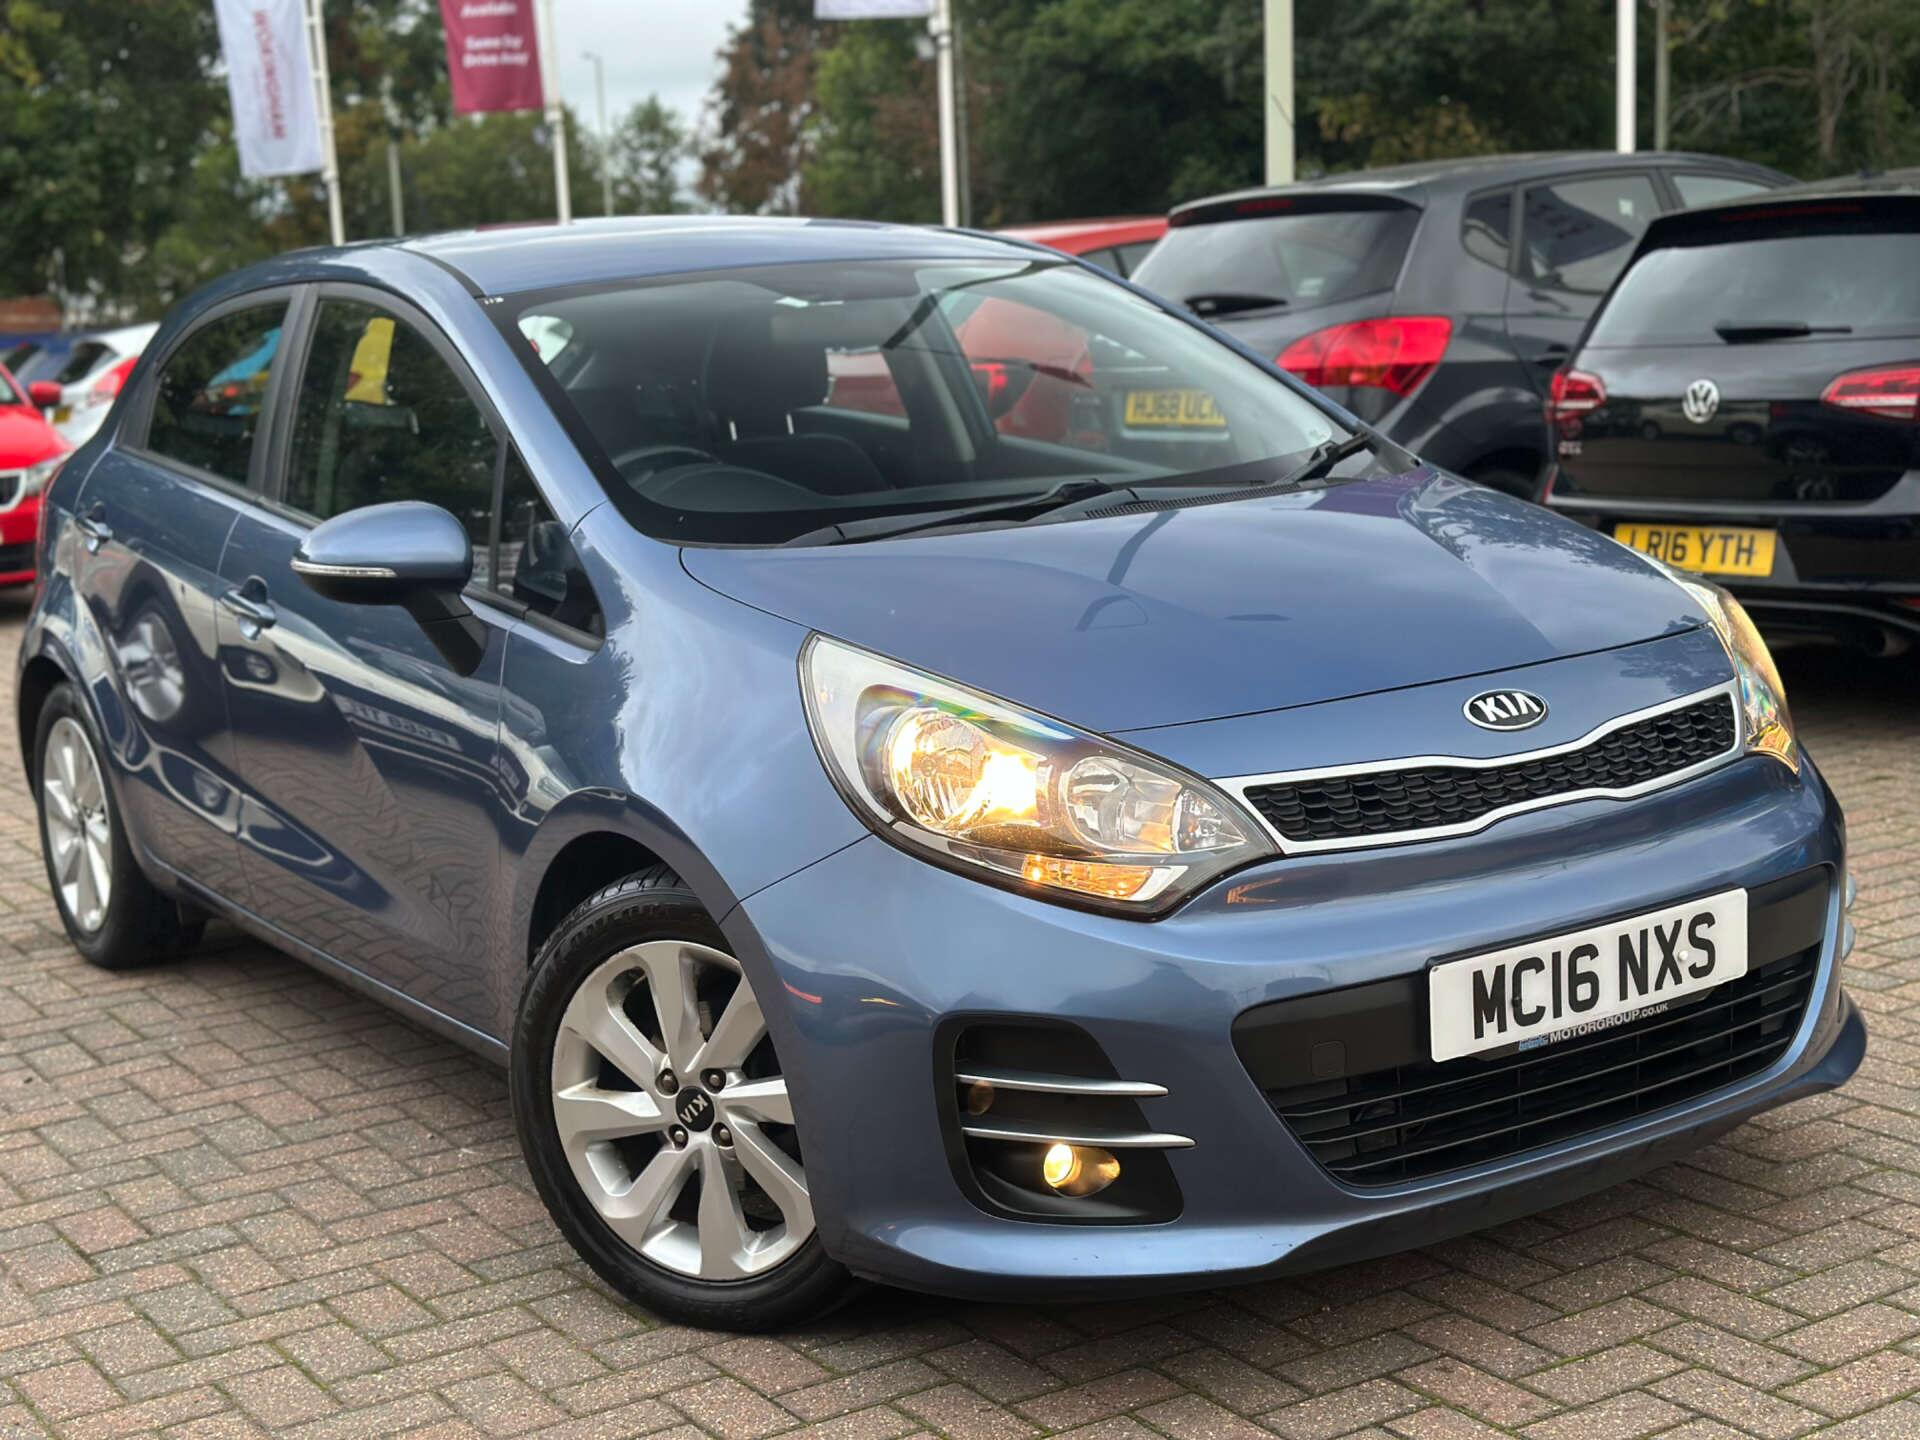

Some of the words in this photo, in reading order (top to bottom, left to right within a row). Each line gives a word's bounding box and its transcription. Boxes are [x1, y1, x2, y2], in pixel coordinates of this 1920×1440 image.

[1699, 533, 1756, 567] YTH
[1473, 692, 1541, 722] KIA
[1472, 943, 1600, 1040] MC16
[1618, 911, 1717, 1002] NXS
